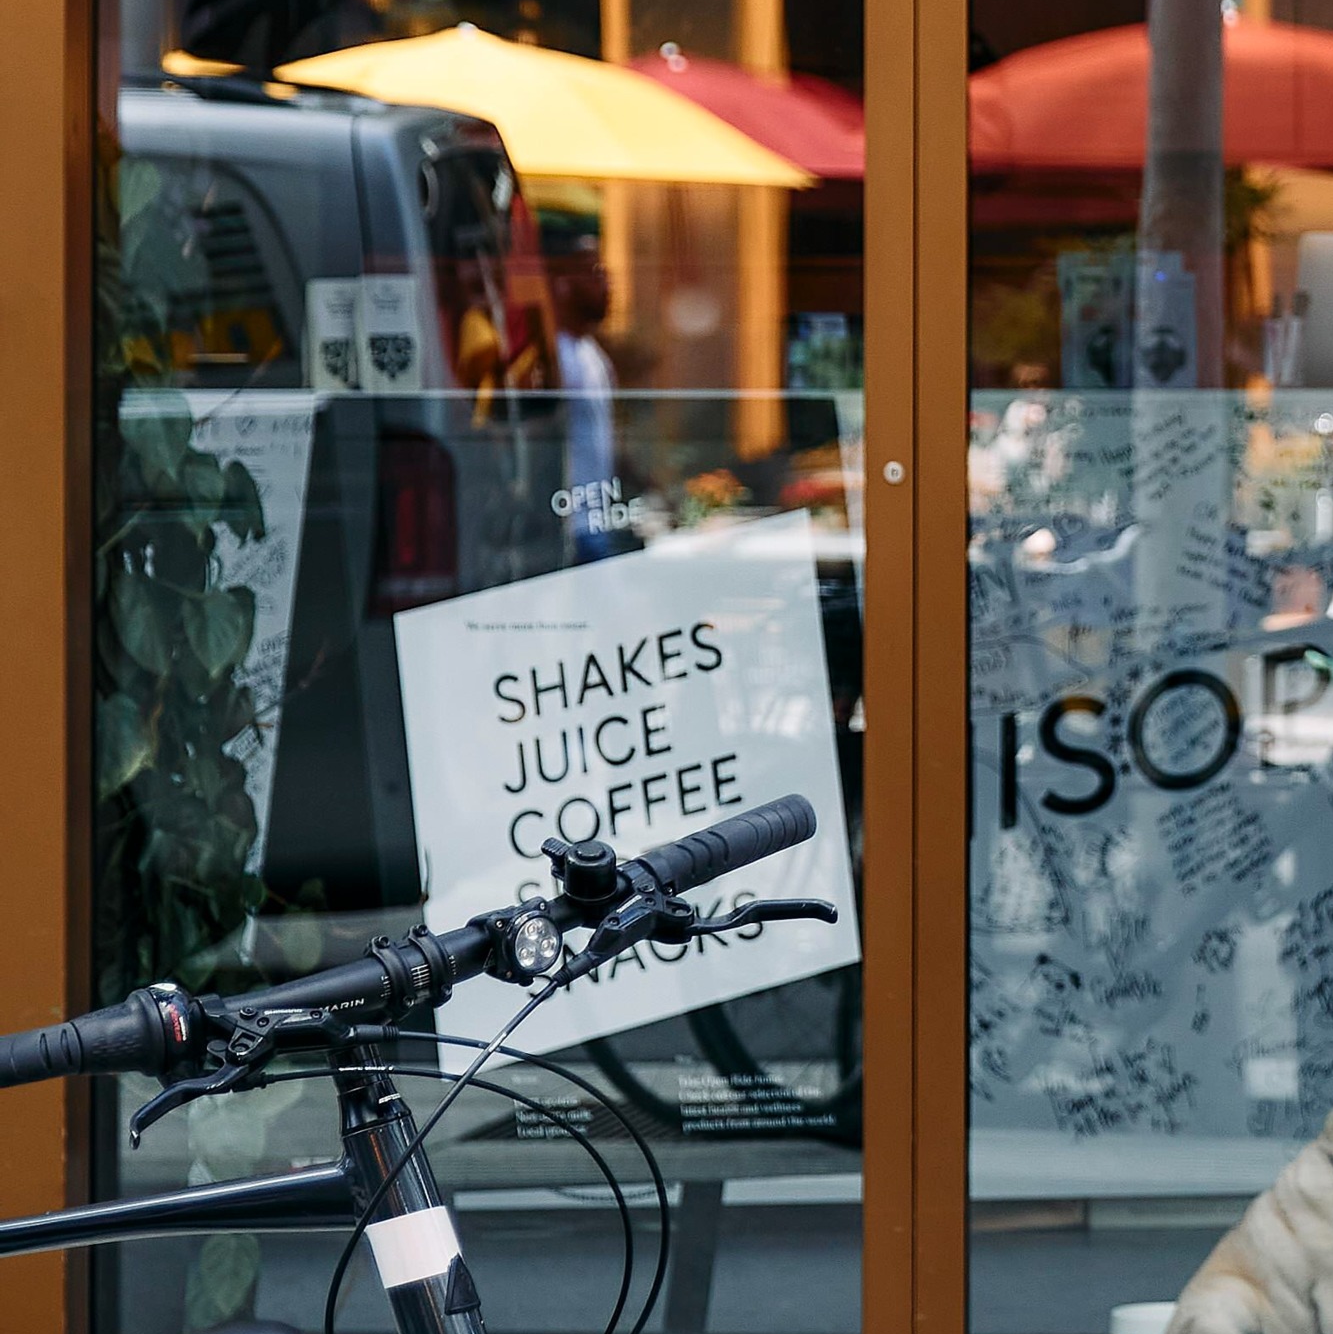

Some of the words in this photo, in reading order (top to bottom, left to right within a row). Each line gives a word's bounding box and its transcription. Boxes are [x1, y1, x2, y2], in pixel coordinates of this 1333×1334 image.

[551, 476, 622, 517] OPEN
[588, 497, 648, 535] RIDE
[494, 622, 723, 723] SHAKES
[503, 703, 673, 794] JUICE
[509, 752, 743, 859] COFFEE
